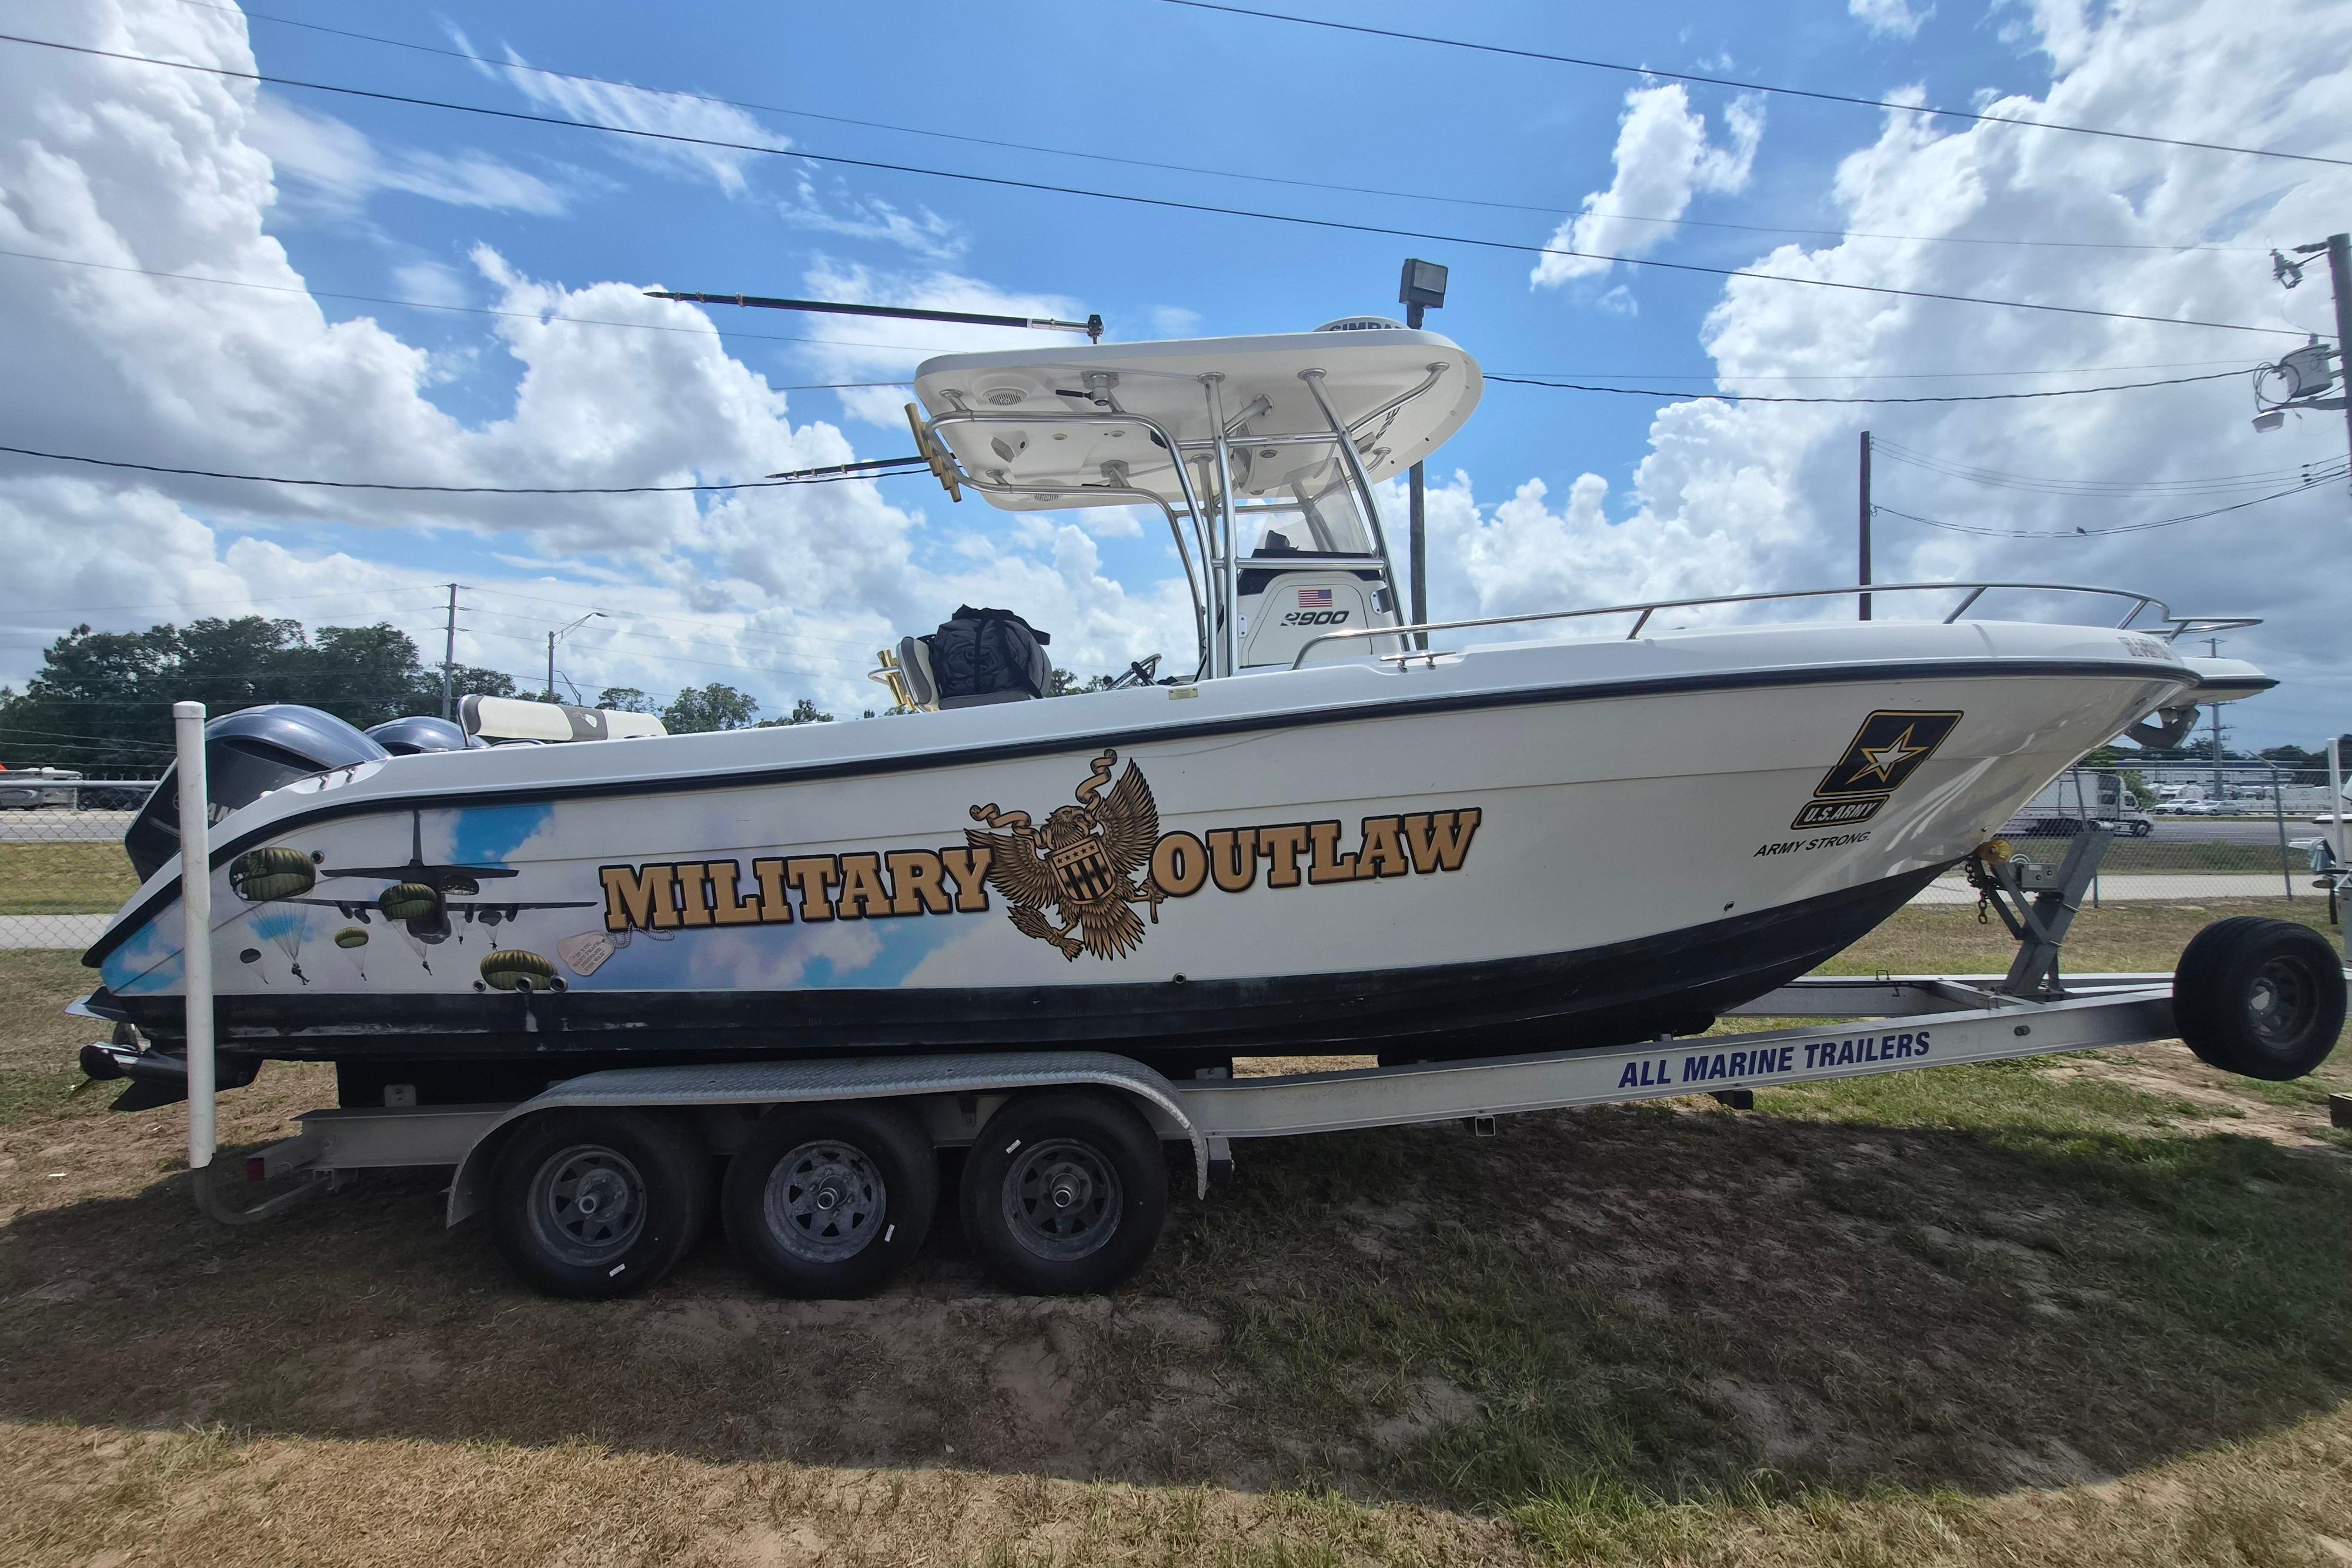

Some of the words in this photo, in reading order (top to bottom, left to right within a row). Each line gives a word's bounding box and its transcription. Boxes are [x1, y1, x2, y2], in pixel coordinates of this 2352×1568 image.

[1280, 610, 1349, 626] 2900
[1753, 840, 1806, 857] ARMY
[599, 846, 994, 932] MILITARY
[1150, 807, 1481, 897] OUTLAW
[1618, 1059, 1671, 1088] ALL
[1683, 1047, 1794, 1082] MARINE
[1803, 1031, 1930, 1068] TRAILERS
